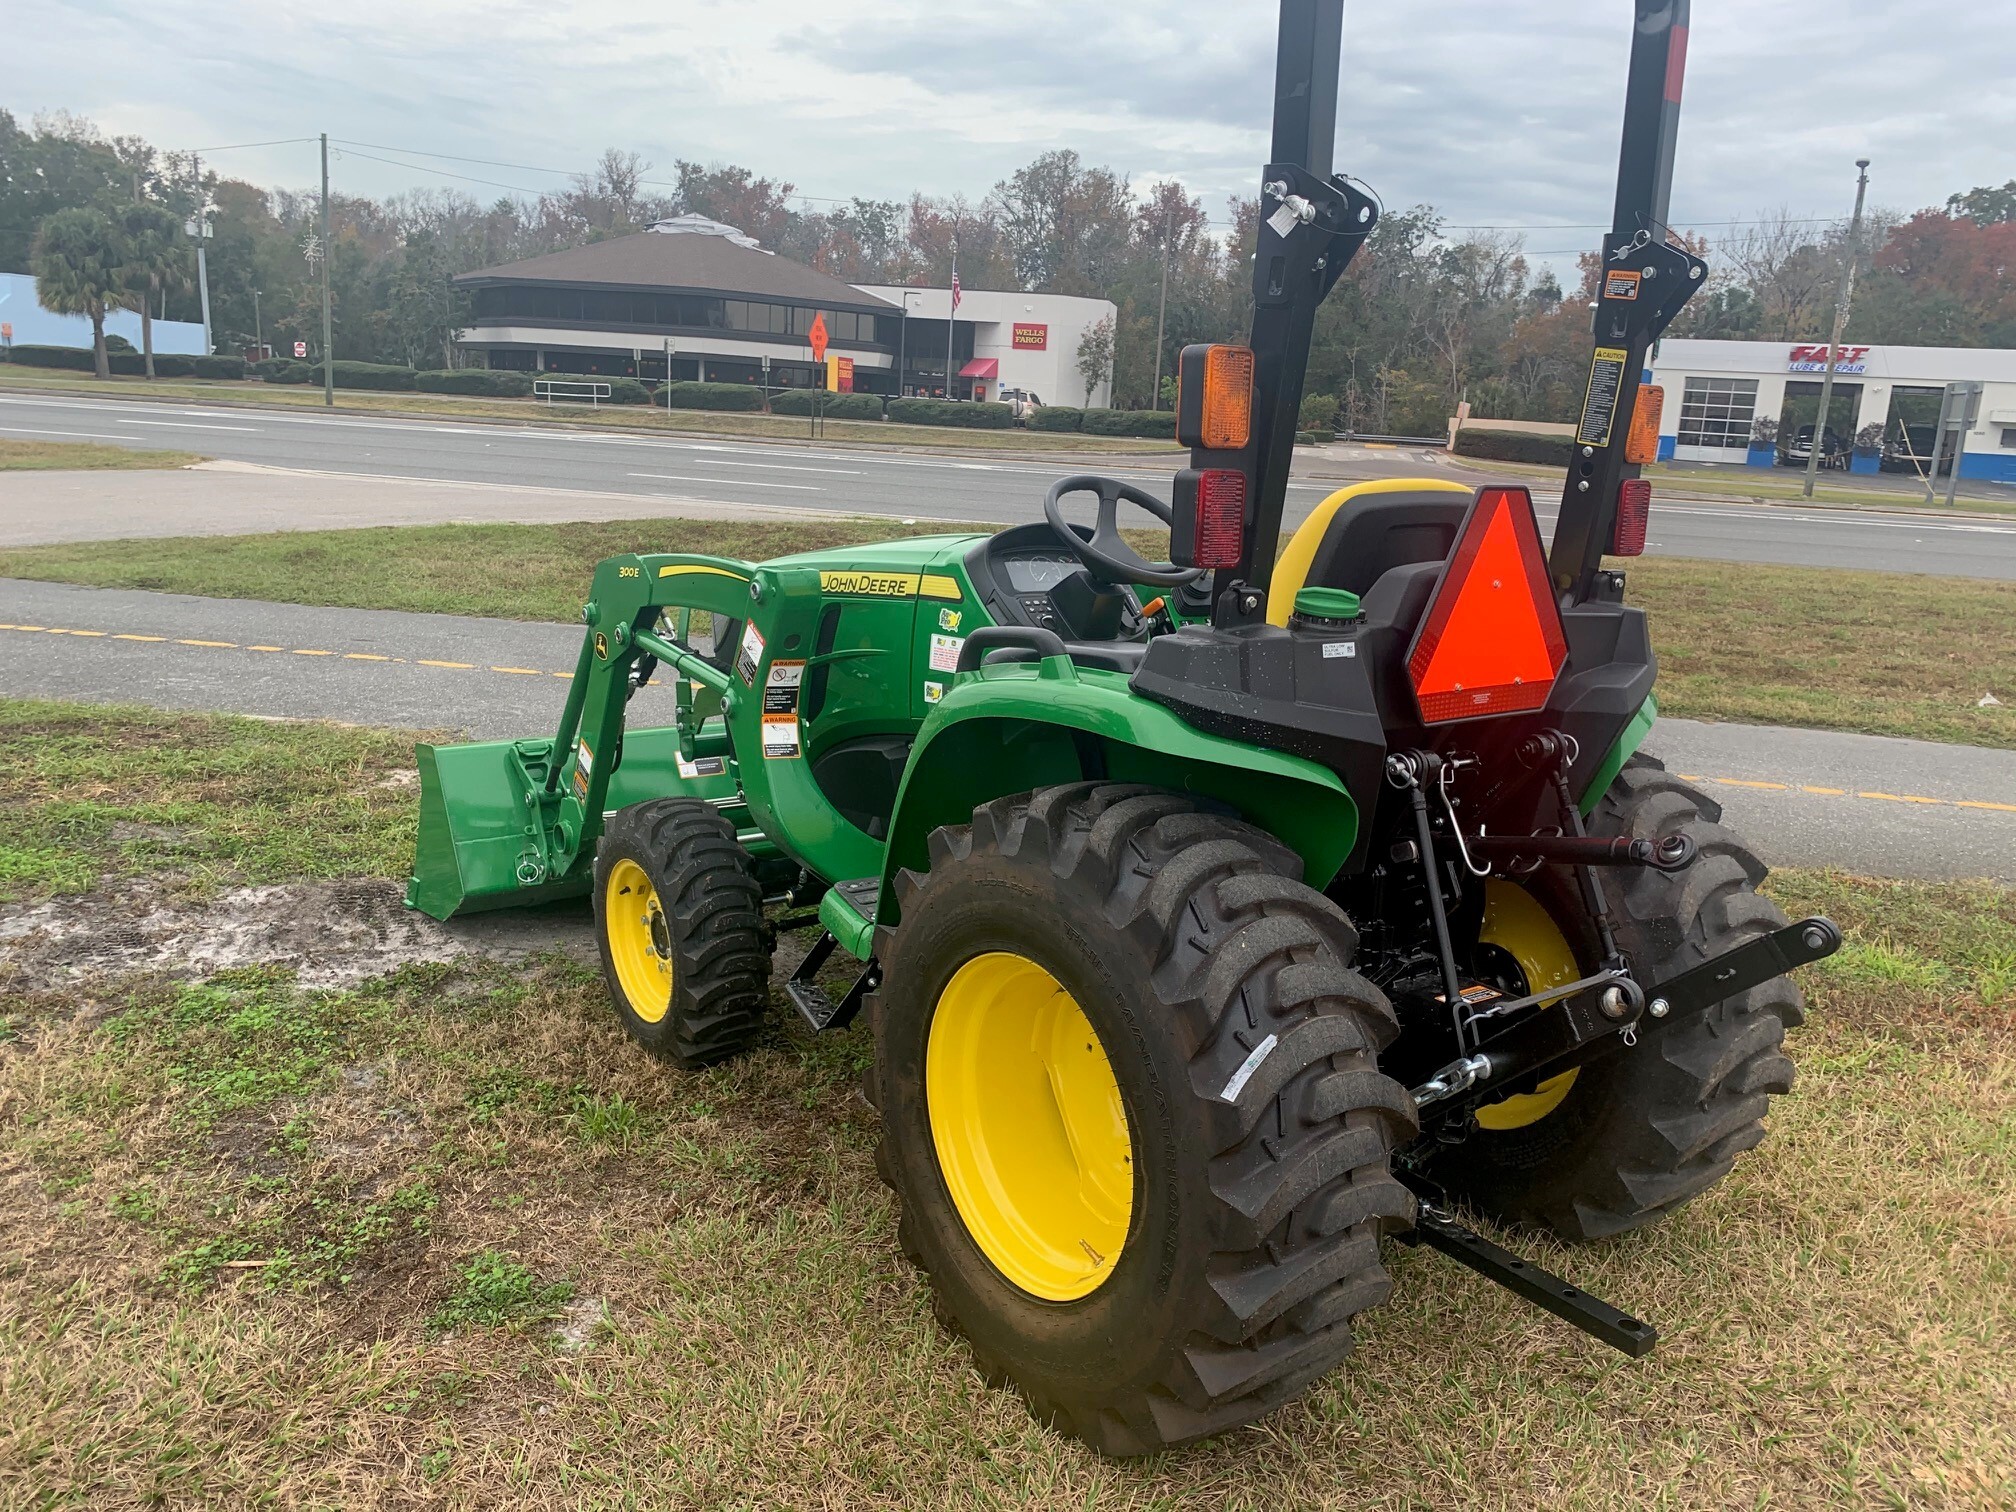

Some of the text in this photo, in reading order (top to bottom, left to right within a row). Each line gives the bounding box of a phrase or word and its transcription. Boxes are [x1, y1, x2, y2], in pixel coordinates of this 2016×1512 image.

[1015, 329, 1045, 337] WELLS
[1015, 336, 1044, 344] FARGO
[1602, 352, 1625, 360] CAUTION
[1790, 346, 1870, 364] FAST
[1789, 363, 1816, 371] LUBE
[1834, 364, 1865, 373] EPAIR
[822, 574, 908, 594] JOHN DEERE
[1064, 921, 1112, 983] THE
